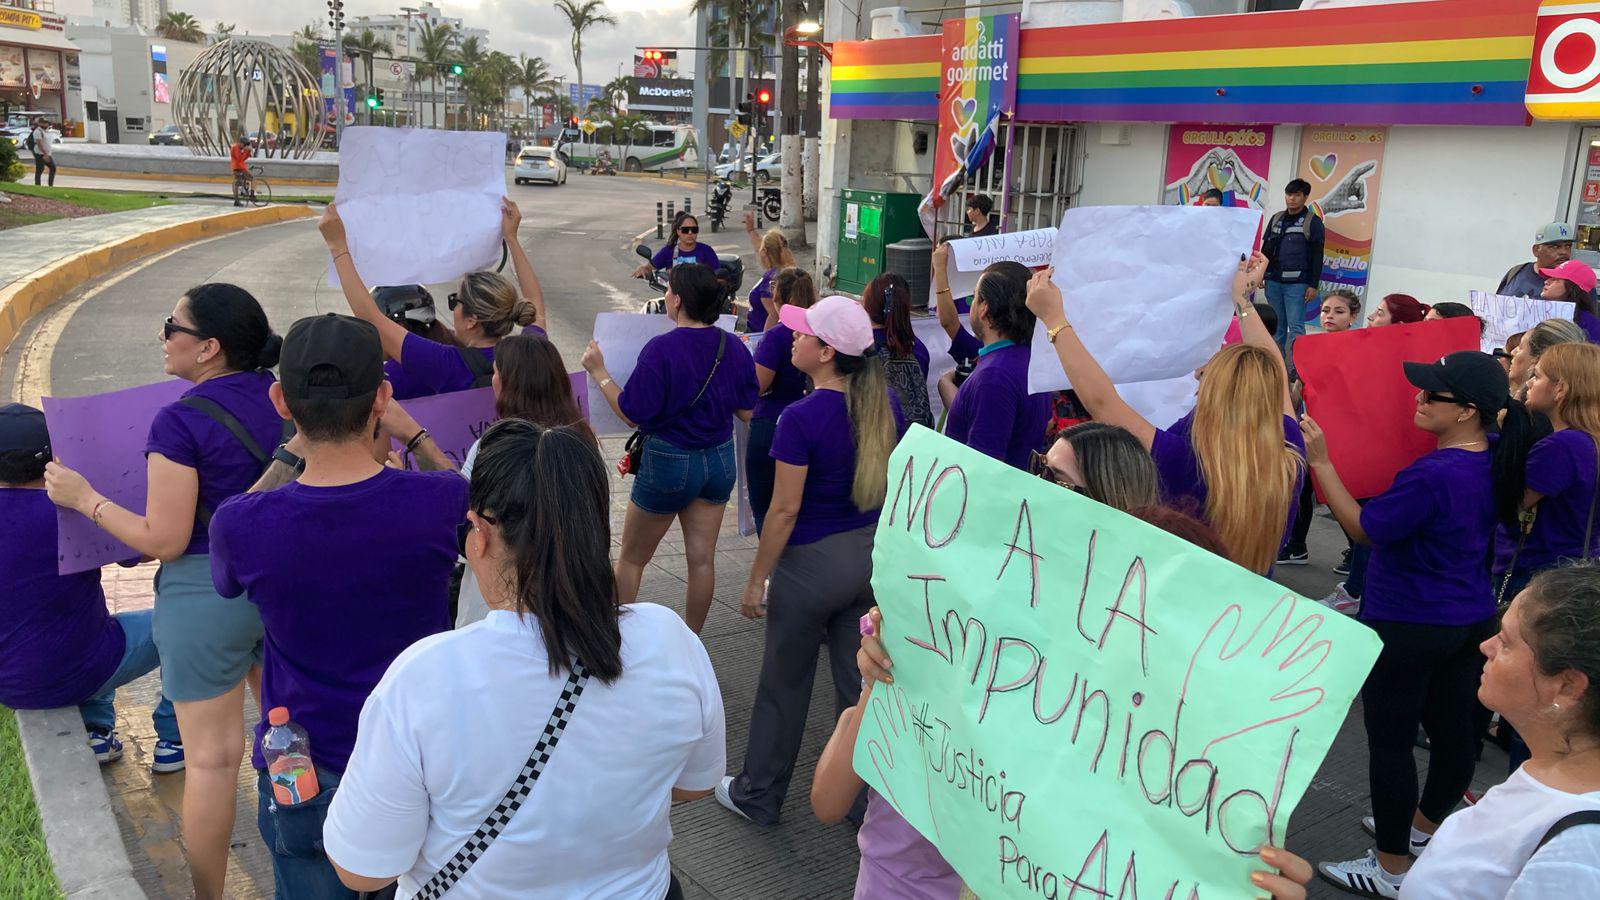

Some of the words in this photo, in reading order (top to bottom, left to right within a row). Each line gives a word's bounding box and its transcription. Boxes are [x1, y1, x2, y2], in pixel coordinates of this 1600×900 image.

[947, 62, 1009, 87] gourmet
[952, 38, 1003, 62] andatti
[1323, 256, 1368, 270] rgullo
[889, 455, 967, 548] NO
[997, 498, 1046, 607] A
[1077, 529, 1158, 677] LA
[904, 574, 1299, 855] Impunidad
[911, 702, 1026, 833] #Justicia
